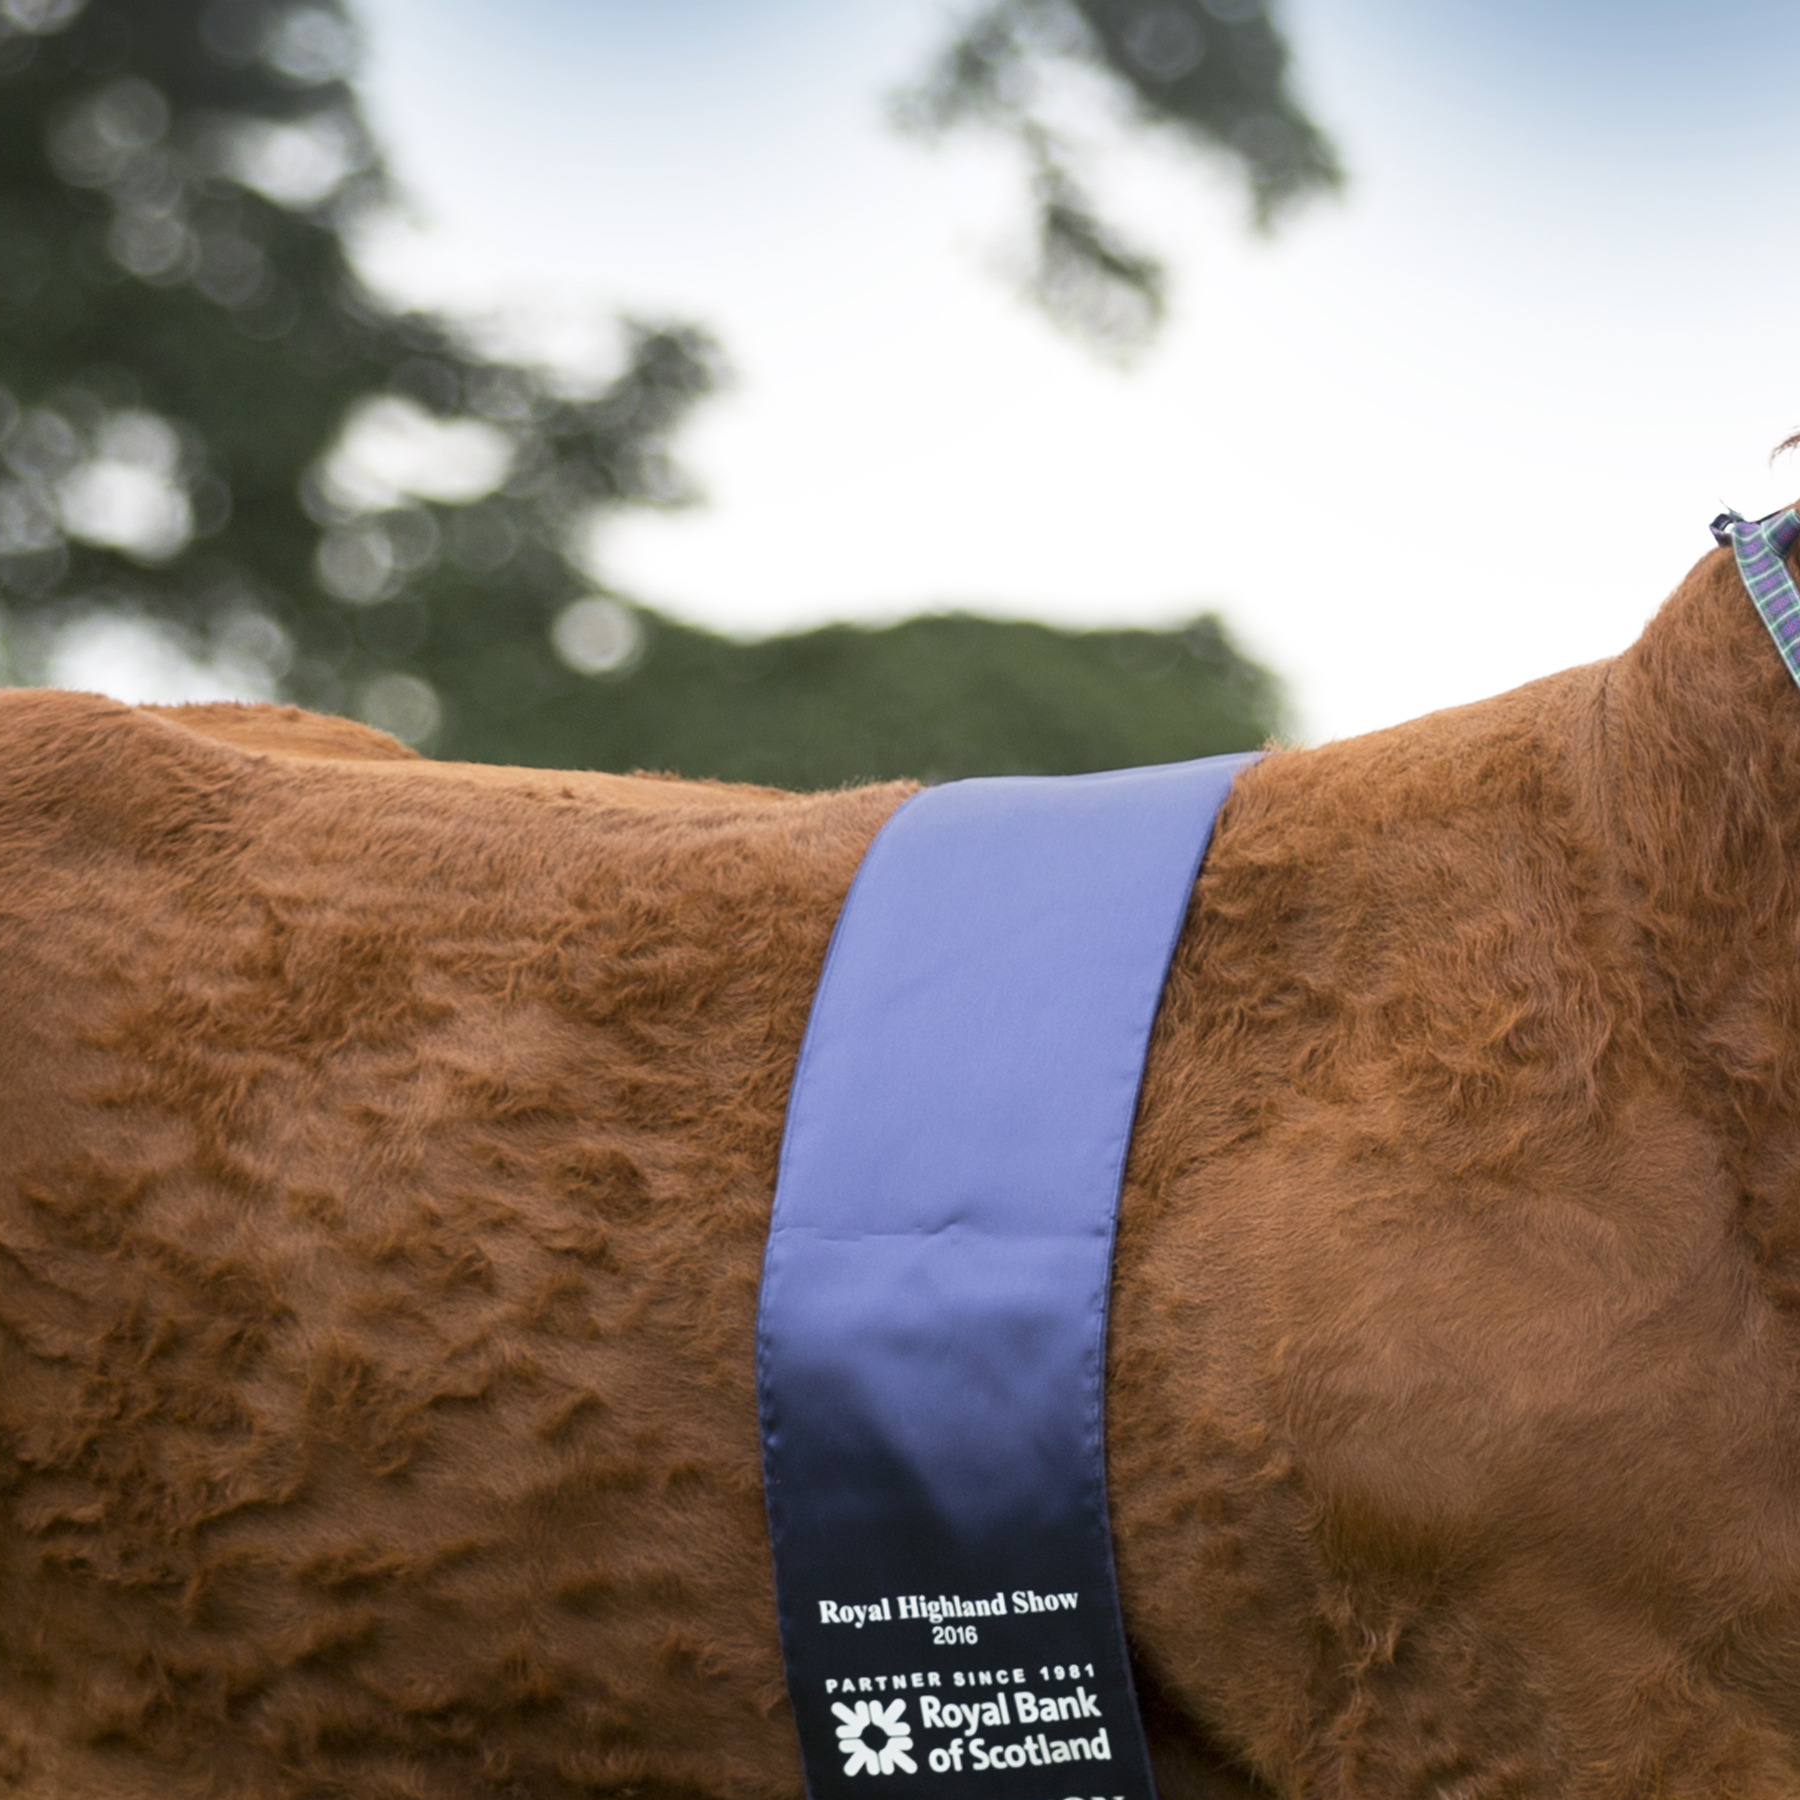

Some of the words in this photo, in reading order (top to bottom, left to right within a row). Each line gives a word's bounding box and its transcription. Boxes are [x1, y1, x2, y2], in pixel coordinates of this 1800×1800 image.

[818, 1598, 892, 1629] Royal
[898, 1591, 1008, 1624] Highland
[1011, 1590, 1080, 1615] Show
[932, 1625, 979, 1646] 2016
[825, 1672, 942, 1694] PARTNER
[953, 1668, 1027, 1687] SINCE
[1039, 1663, 1096, 1682] 1981
[920, 1692, 1010, 1738] Royal
[1015, 1686, 1102, 1725] Bank
[928, 1737, 964, 1773] of
[968, 1727, 1112, 1772] Scotland
